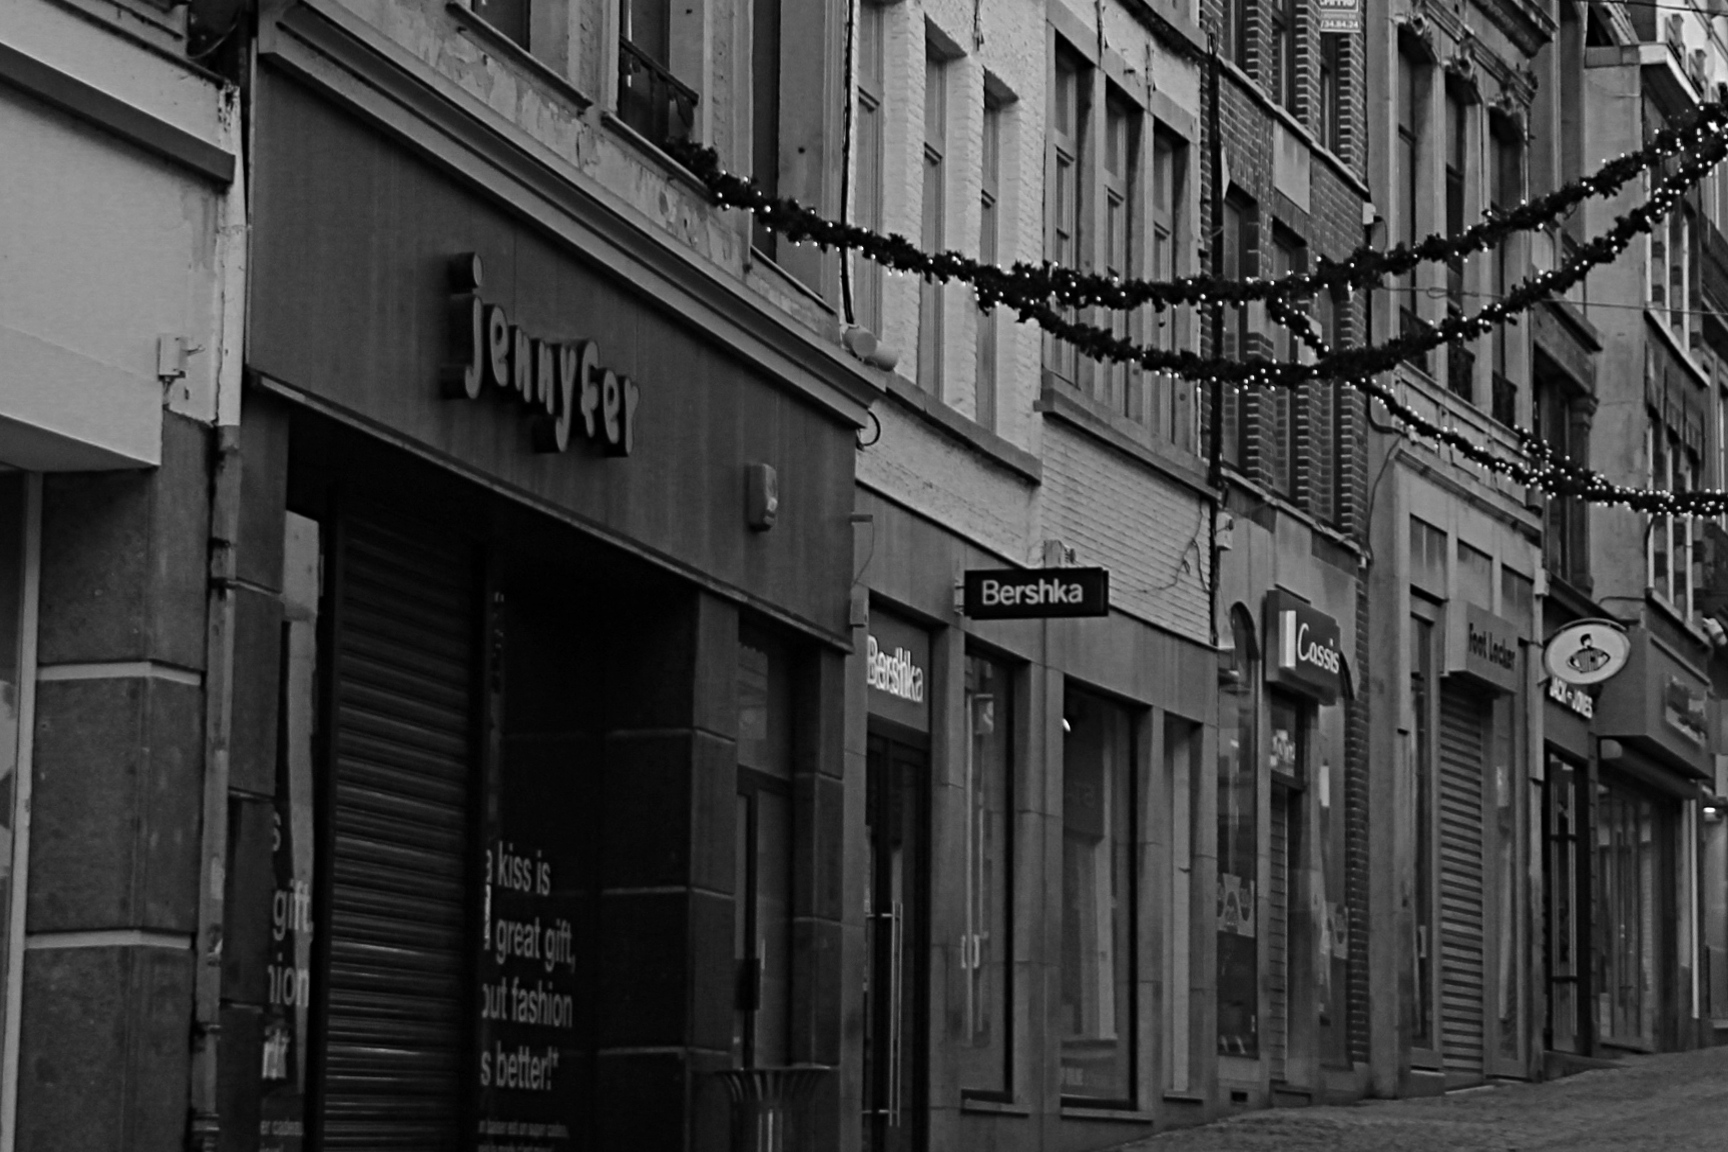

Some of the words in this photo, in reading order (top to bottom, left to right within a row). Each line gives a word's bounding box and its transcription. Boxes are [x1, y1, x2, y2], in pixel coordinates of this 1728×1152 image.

[464, 254, 640, 455] jennyfer
[981, 577, 1084, 606] Bershka
[867, 634, 924, 703] Bershka
[1297, 622, 1340, 674] Cassis
[498, 840, 532, 892] kiss
[536, 849, 551, 896] is
[495, 916, 540, 965] great
[544, 918, 576, 973] gift,
[511, 977, 573, 1028] fashion
